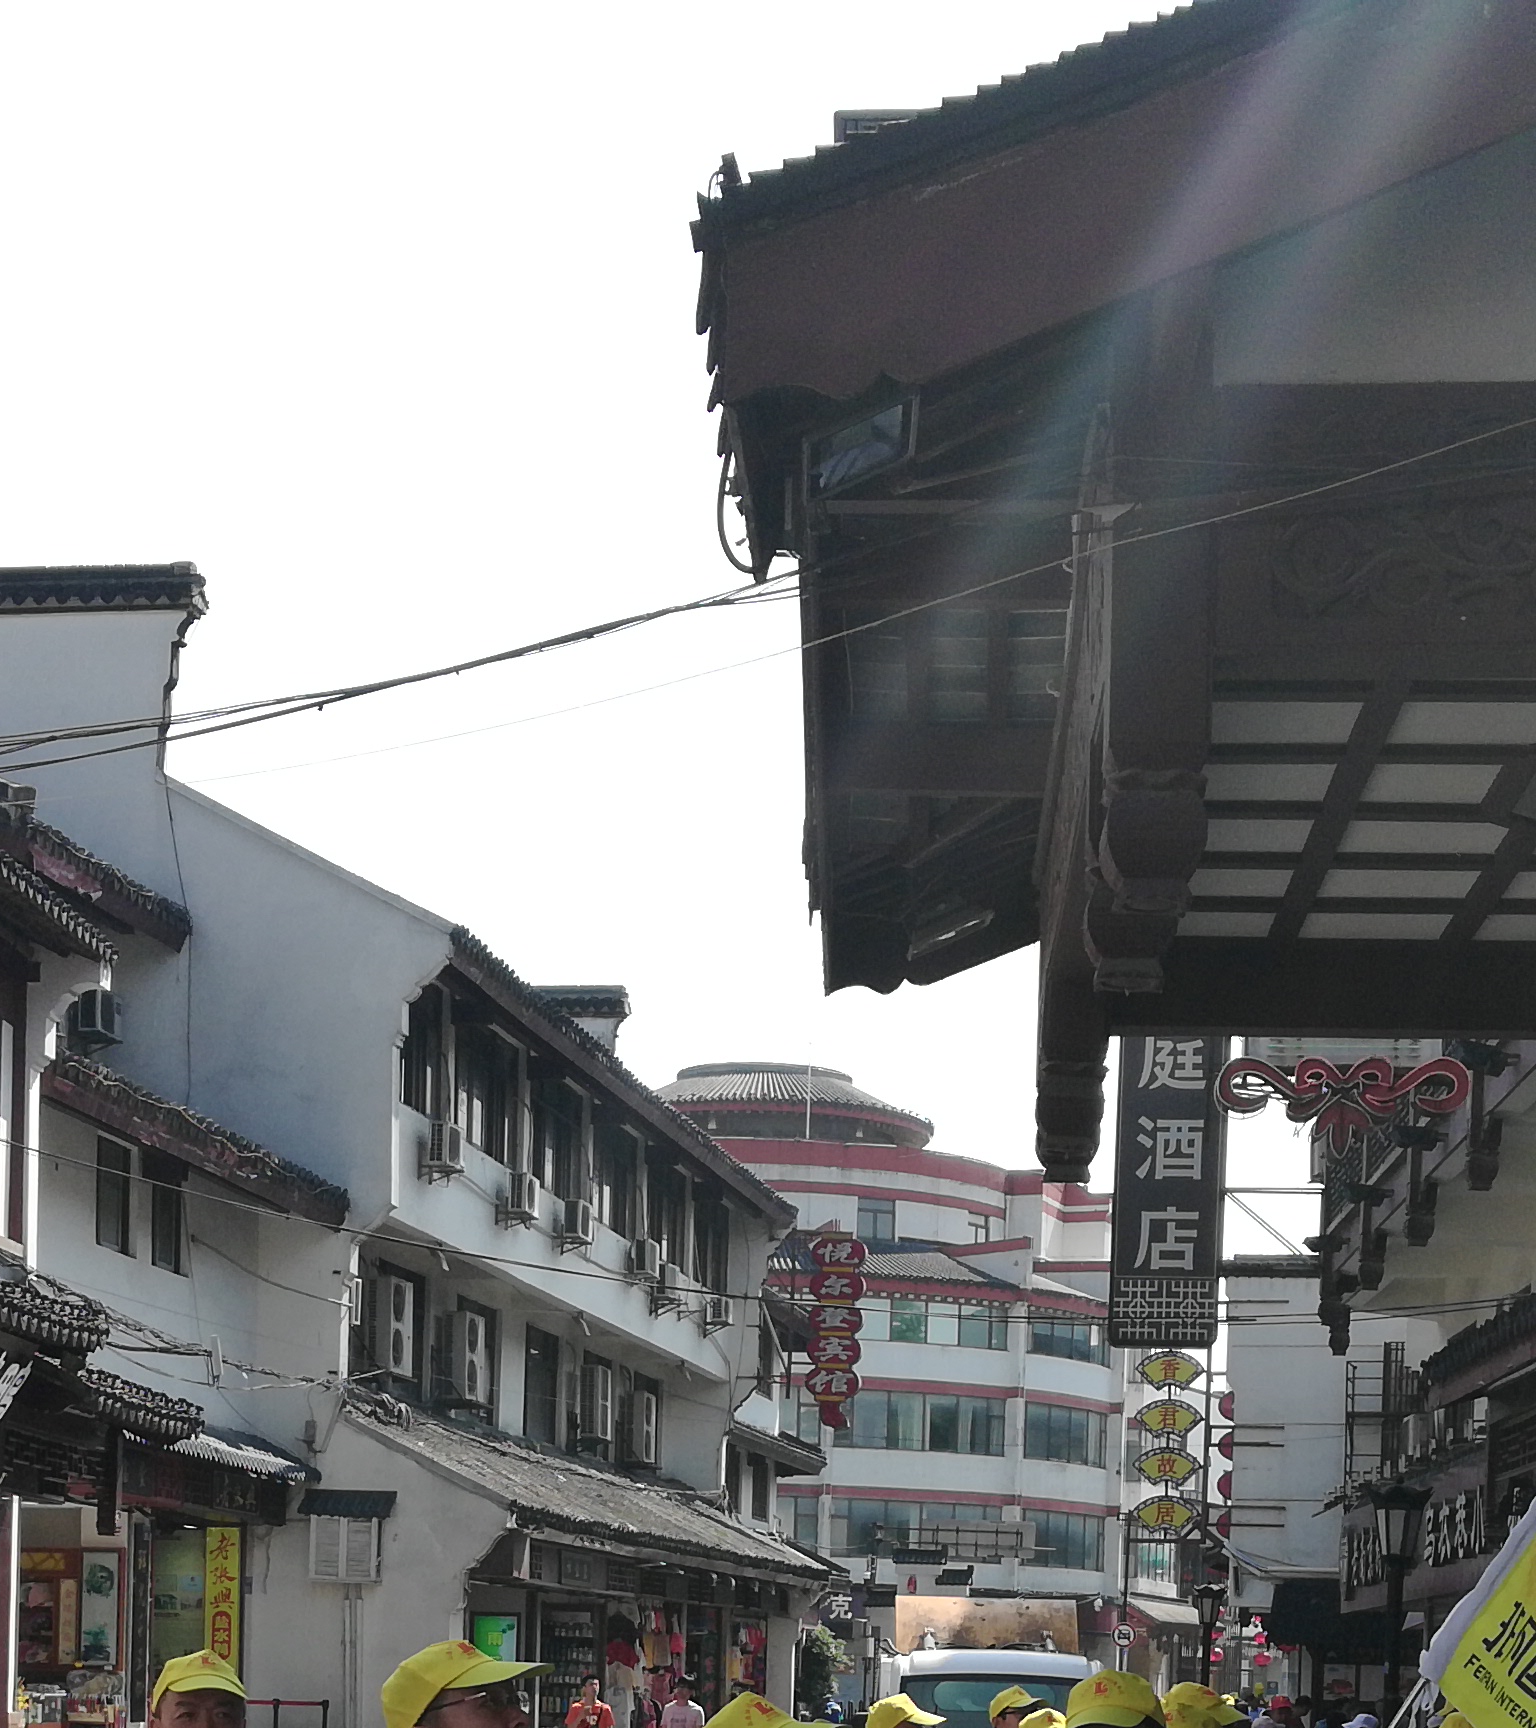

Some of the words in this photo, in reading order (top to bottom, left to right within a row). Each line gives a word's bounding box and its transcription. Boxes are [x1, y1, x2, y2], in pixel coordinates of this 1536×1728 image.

[1133, 1037, 1207, 1271] 庭酒店
[1153, 1357, 1181, 1525] 香君故居
